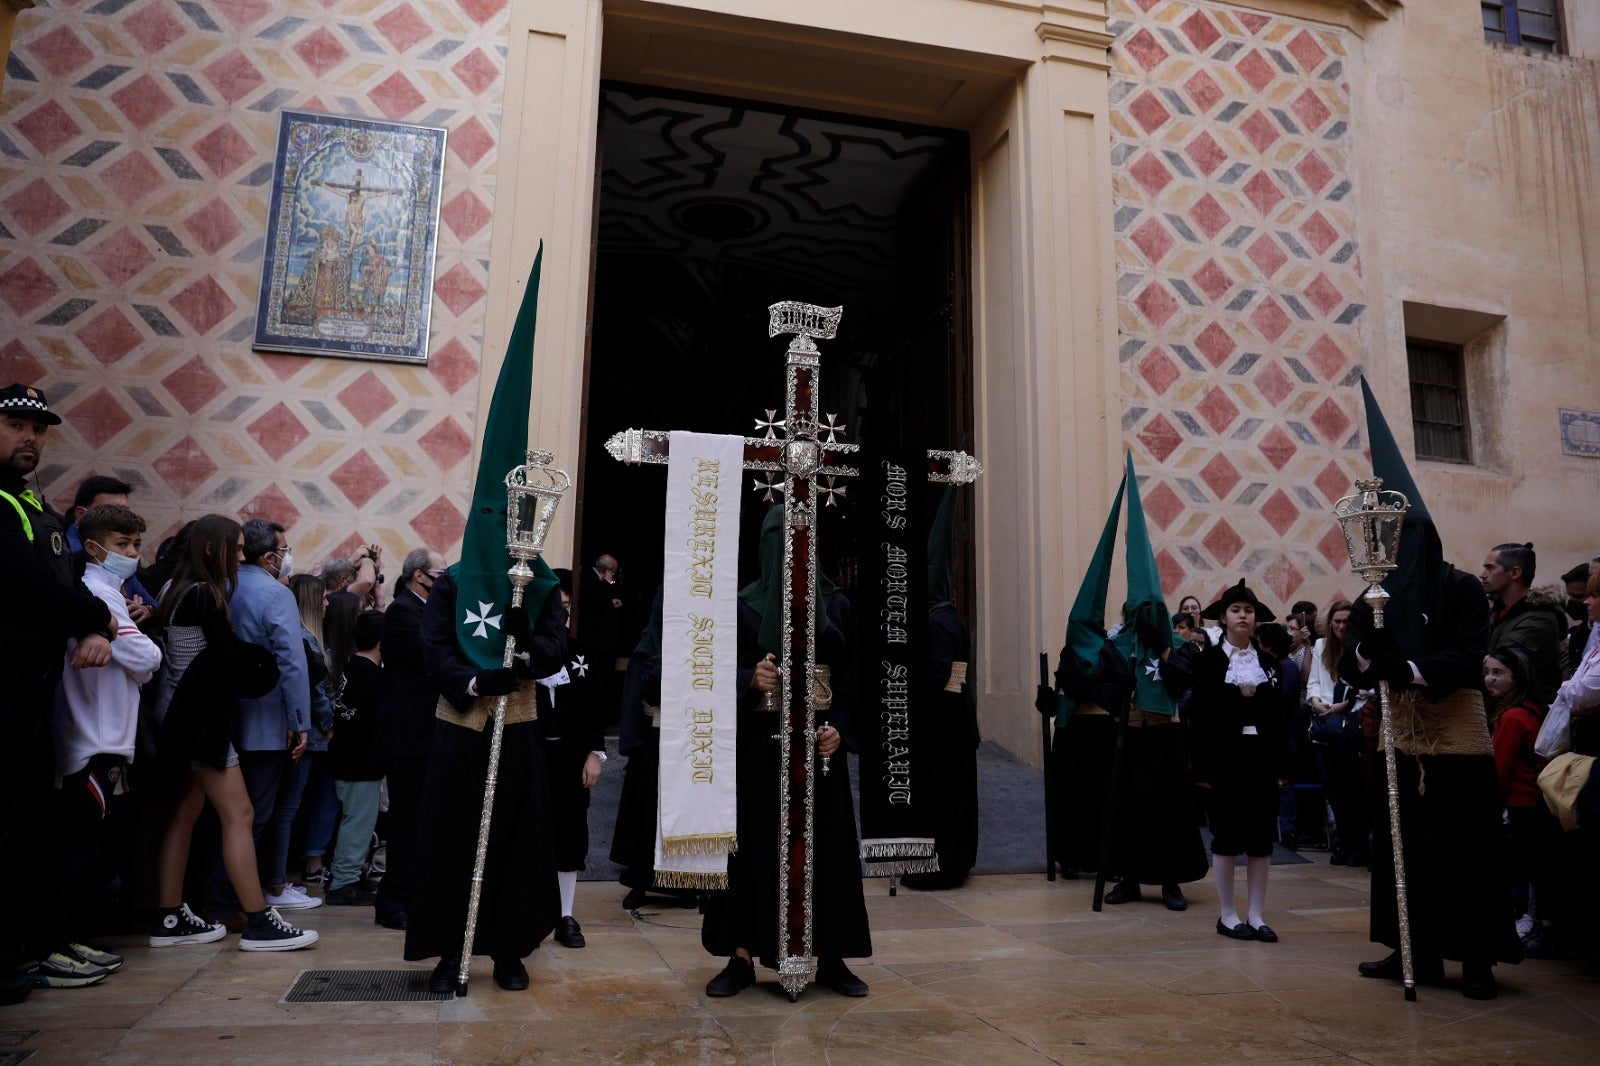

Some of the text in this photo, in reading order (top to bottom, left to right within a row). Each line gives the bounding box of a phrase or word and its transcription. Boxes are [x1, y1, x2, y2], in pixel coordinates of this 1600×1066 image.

[880, 461, 908, 530] MORS
[880, 542, 908, 646] MORTEM
[685, 613, 714, 691] SICUT
[685, 707, 714, 785] DIXIT
